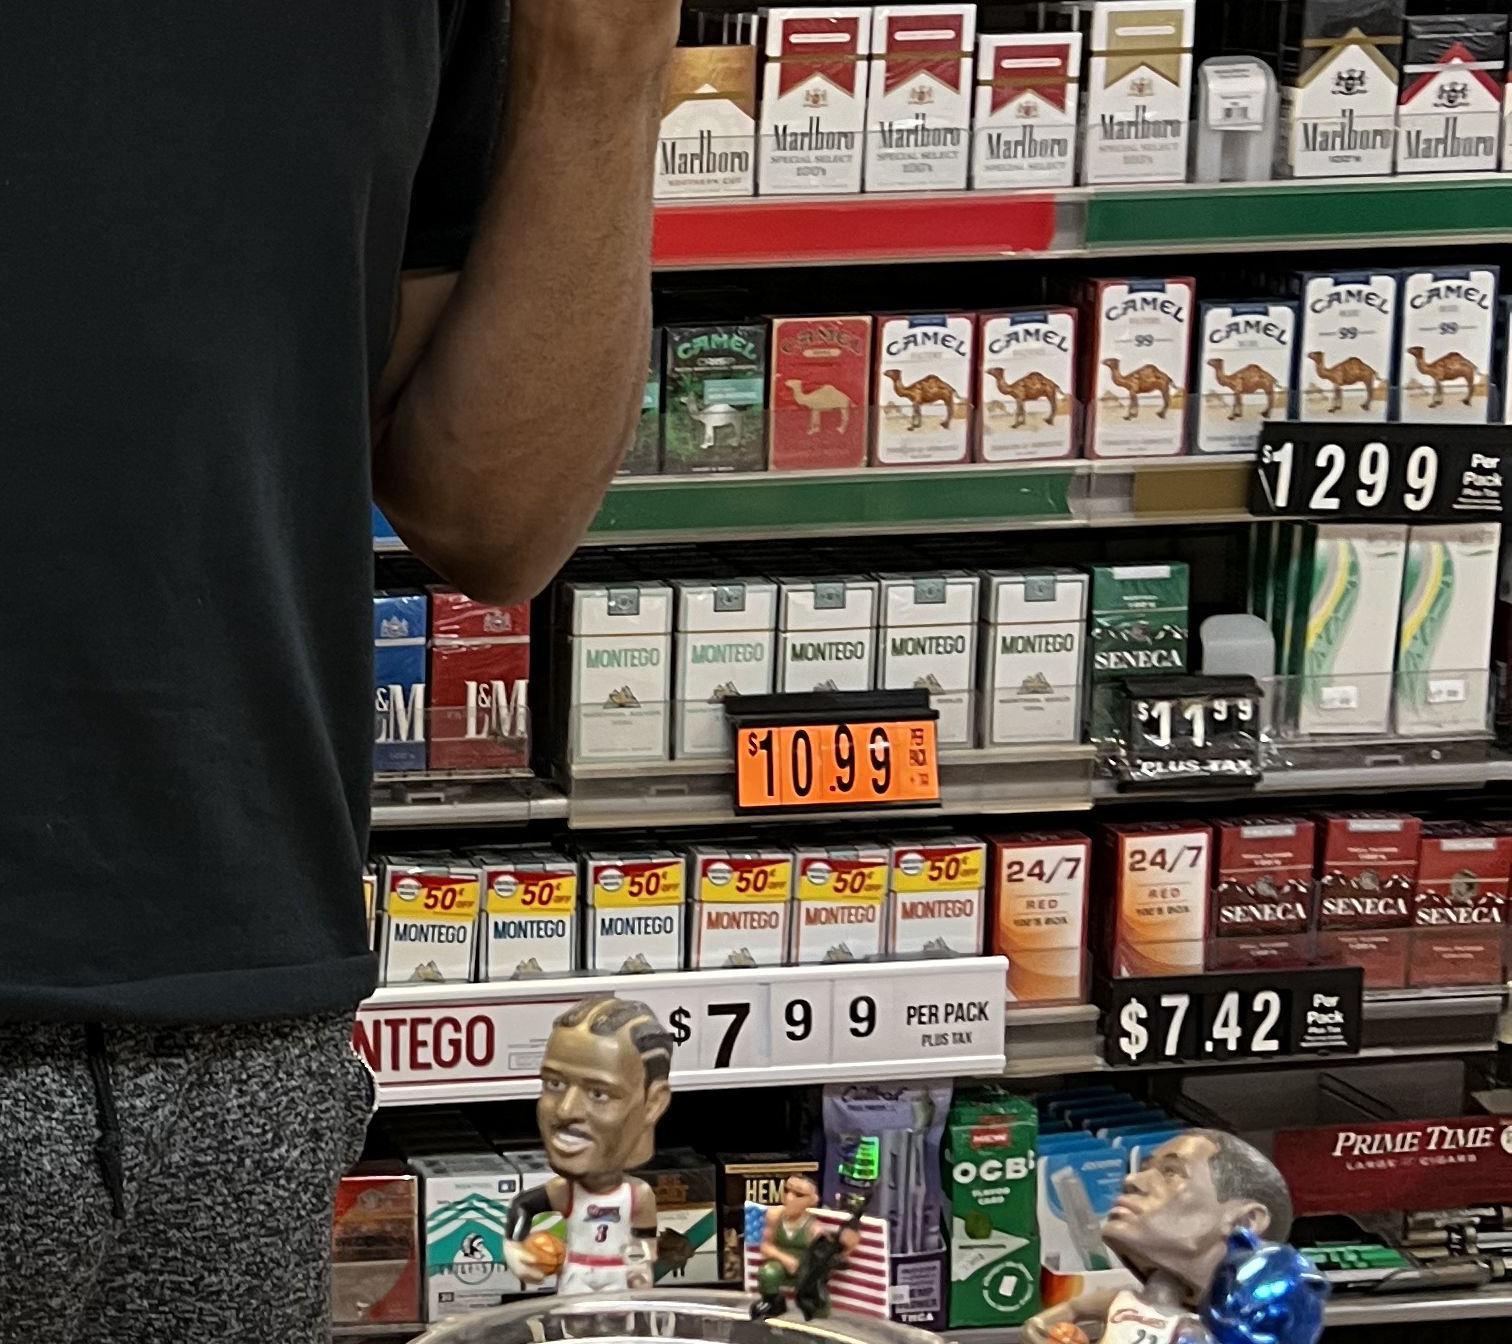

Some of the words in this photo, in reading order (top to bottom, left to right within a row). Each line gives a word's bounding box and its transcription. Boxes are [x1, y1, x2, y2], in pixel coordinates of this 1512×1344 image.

[658, 129, 750, 177] Marlboro
[1104, 294, 1187, 325] CAMEL
[885, 333, 968, 359] CAMEL
[586, 648, 660, 668] MONTEGO
[1094, 649, 1183, 671] SENECA
[1007, 856, 1081, 883] 24/7
[394, 923, 467, 944] MONTEGO
[906, 1004, 938, 1026] PER
[944, 1001, 989, 1023] PACK
[352, 1014, 496, 1074] NTEGO
[1333, 1131, 1419, 1157] PRIME
[1428, 1126, 1495, 1149] TIME
